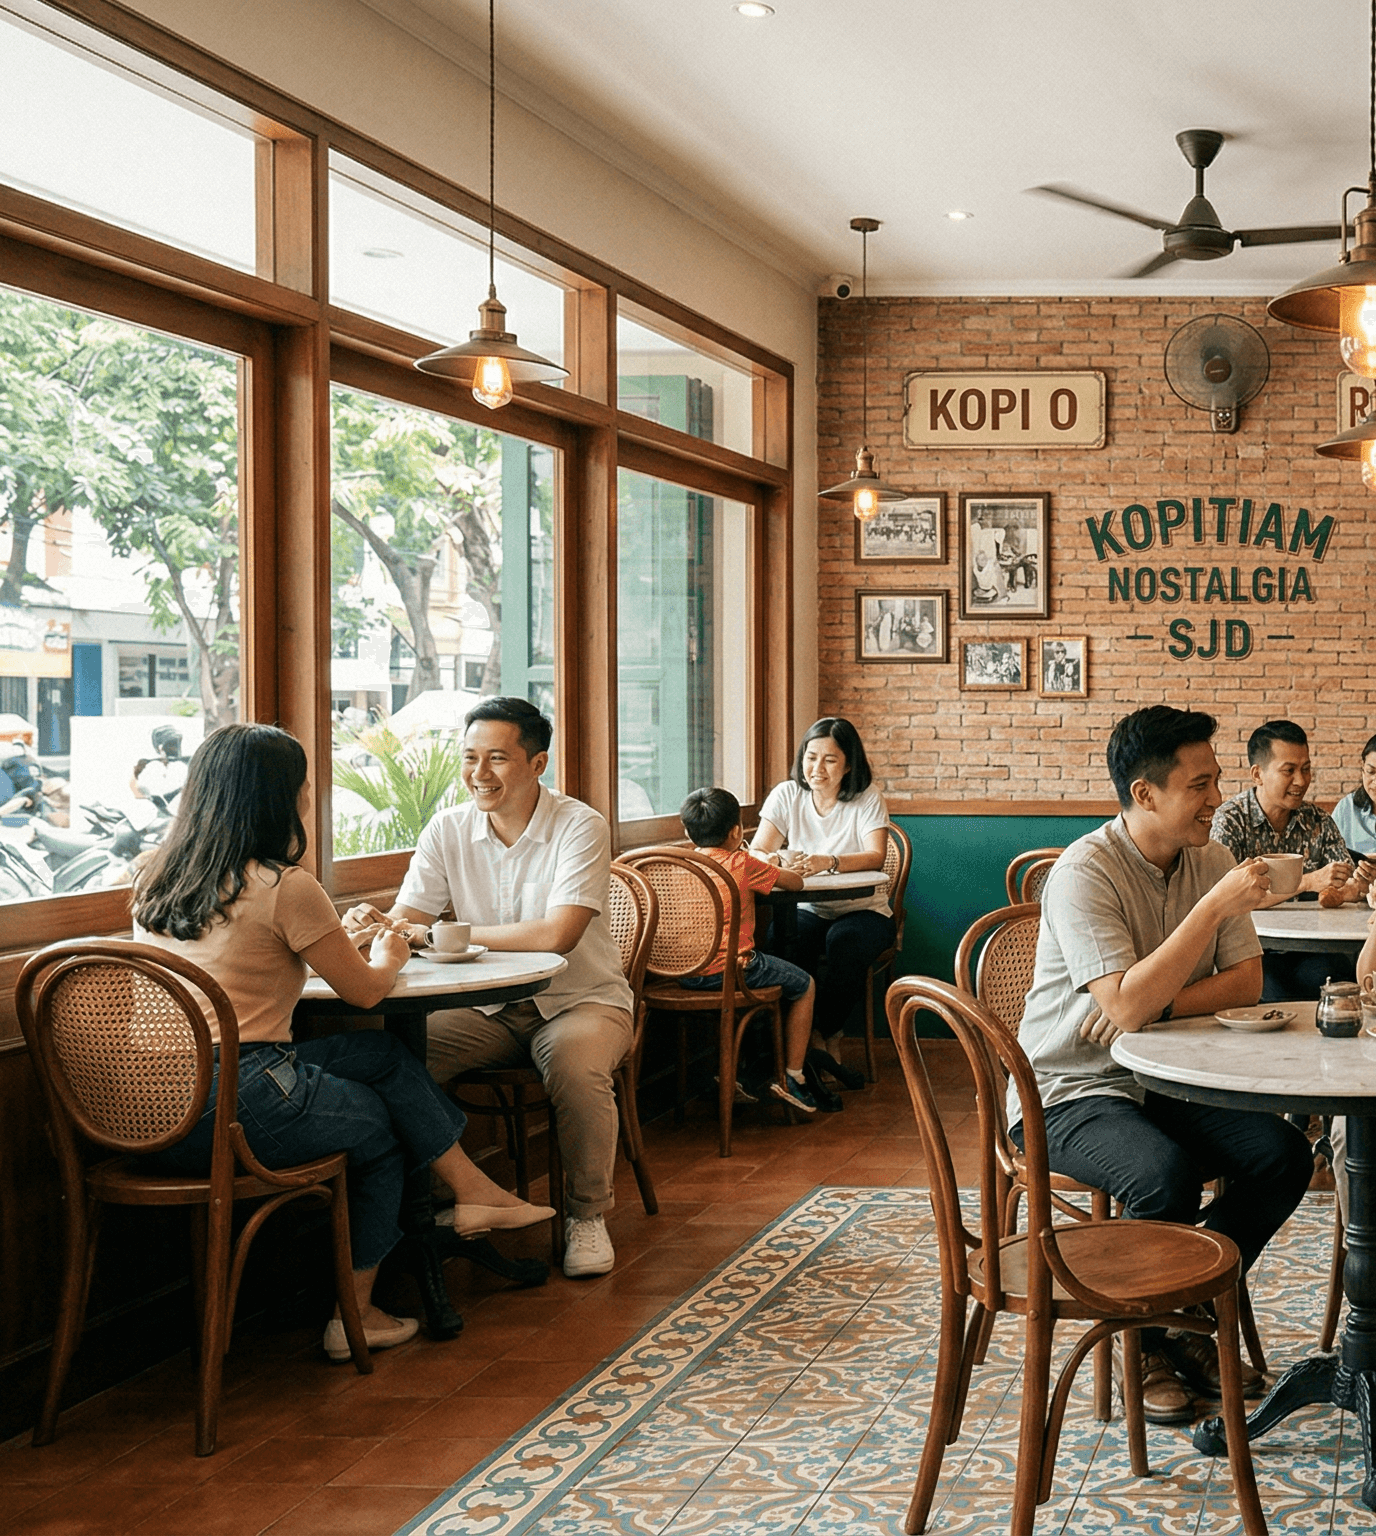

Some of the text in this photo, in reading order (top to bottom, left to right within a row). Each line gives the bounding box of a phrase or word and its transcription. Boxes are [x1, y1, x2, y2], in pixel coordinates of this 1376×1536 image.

[930, 388, 1078, 431] KOPI O
[1085, 498, 1336, 563] KOPITIAM
[1109, 566, 1315, 604] NOSTALGIA
[1168, 618, 1253, 660] SJD
